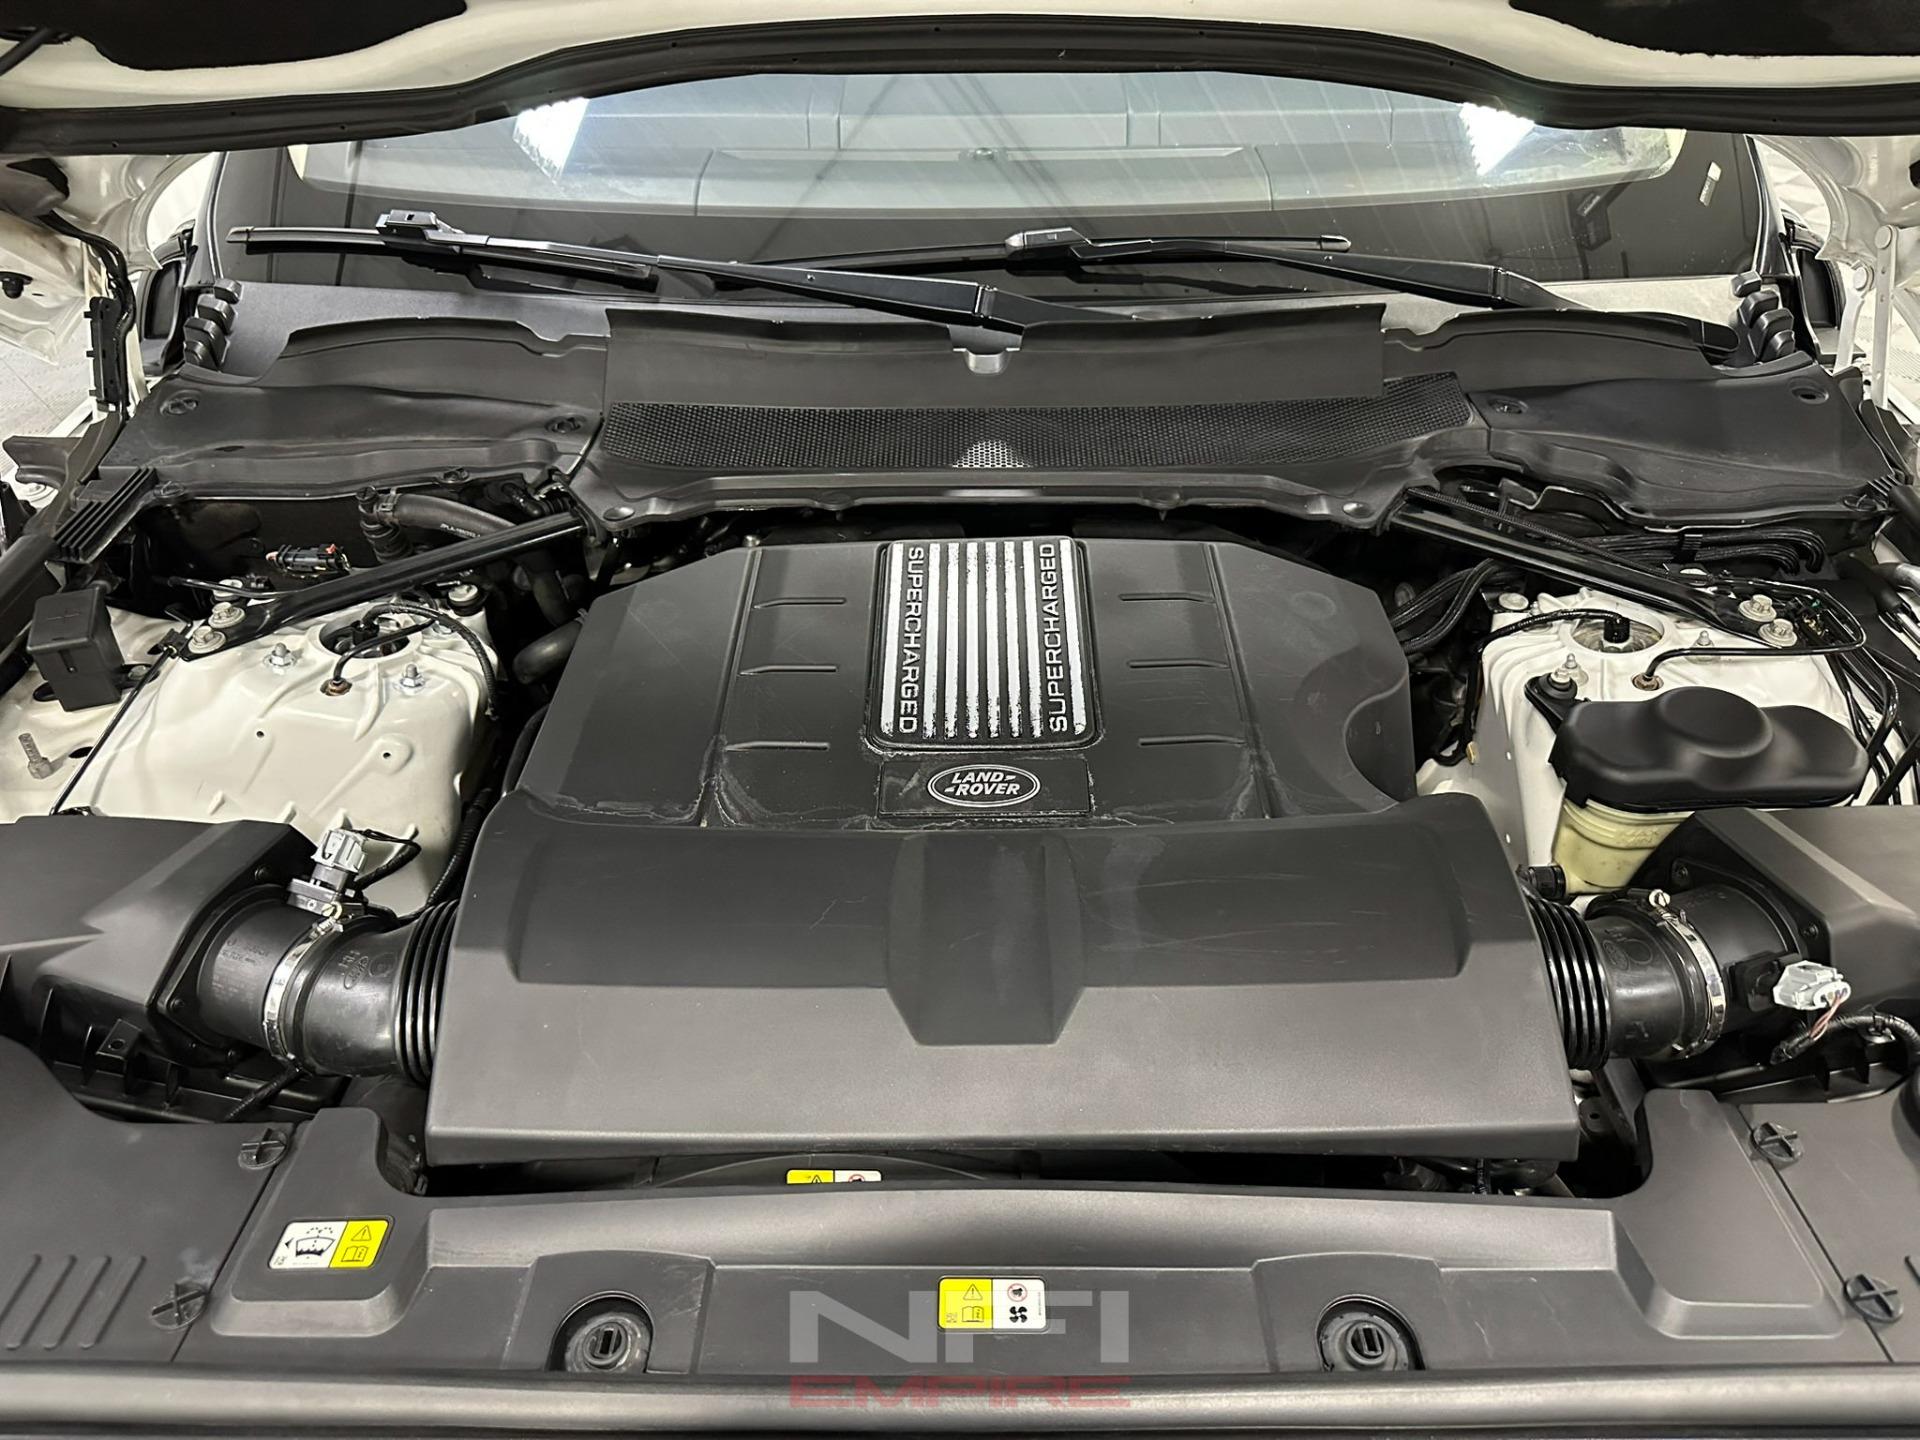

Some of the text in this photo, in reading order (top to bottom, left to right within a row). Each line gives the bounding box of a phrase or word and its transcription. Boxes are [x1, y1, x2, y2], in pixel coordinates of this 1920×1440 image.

[899, 546, 924, 734] SUPERCHARGED
[1039, 543, 1068, 732] SUPERCHARGED
[955, 783, 1021, 796] ROVER
